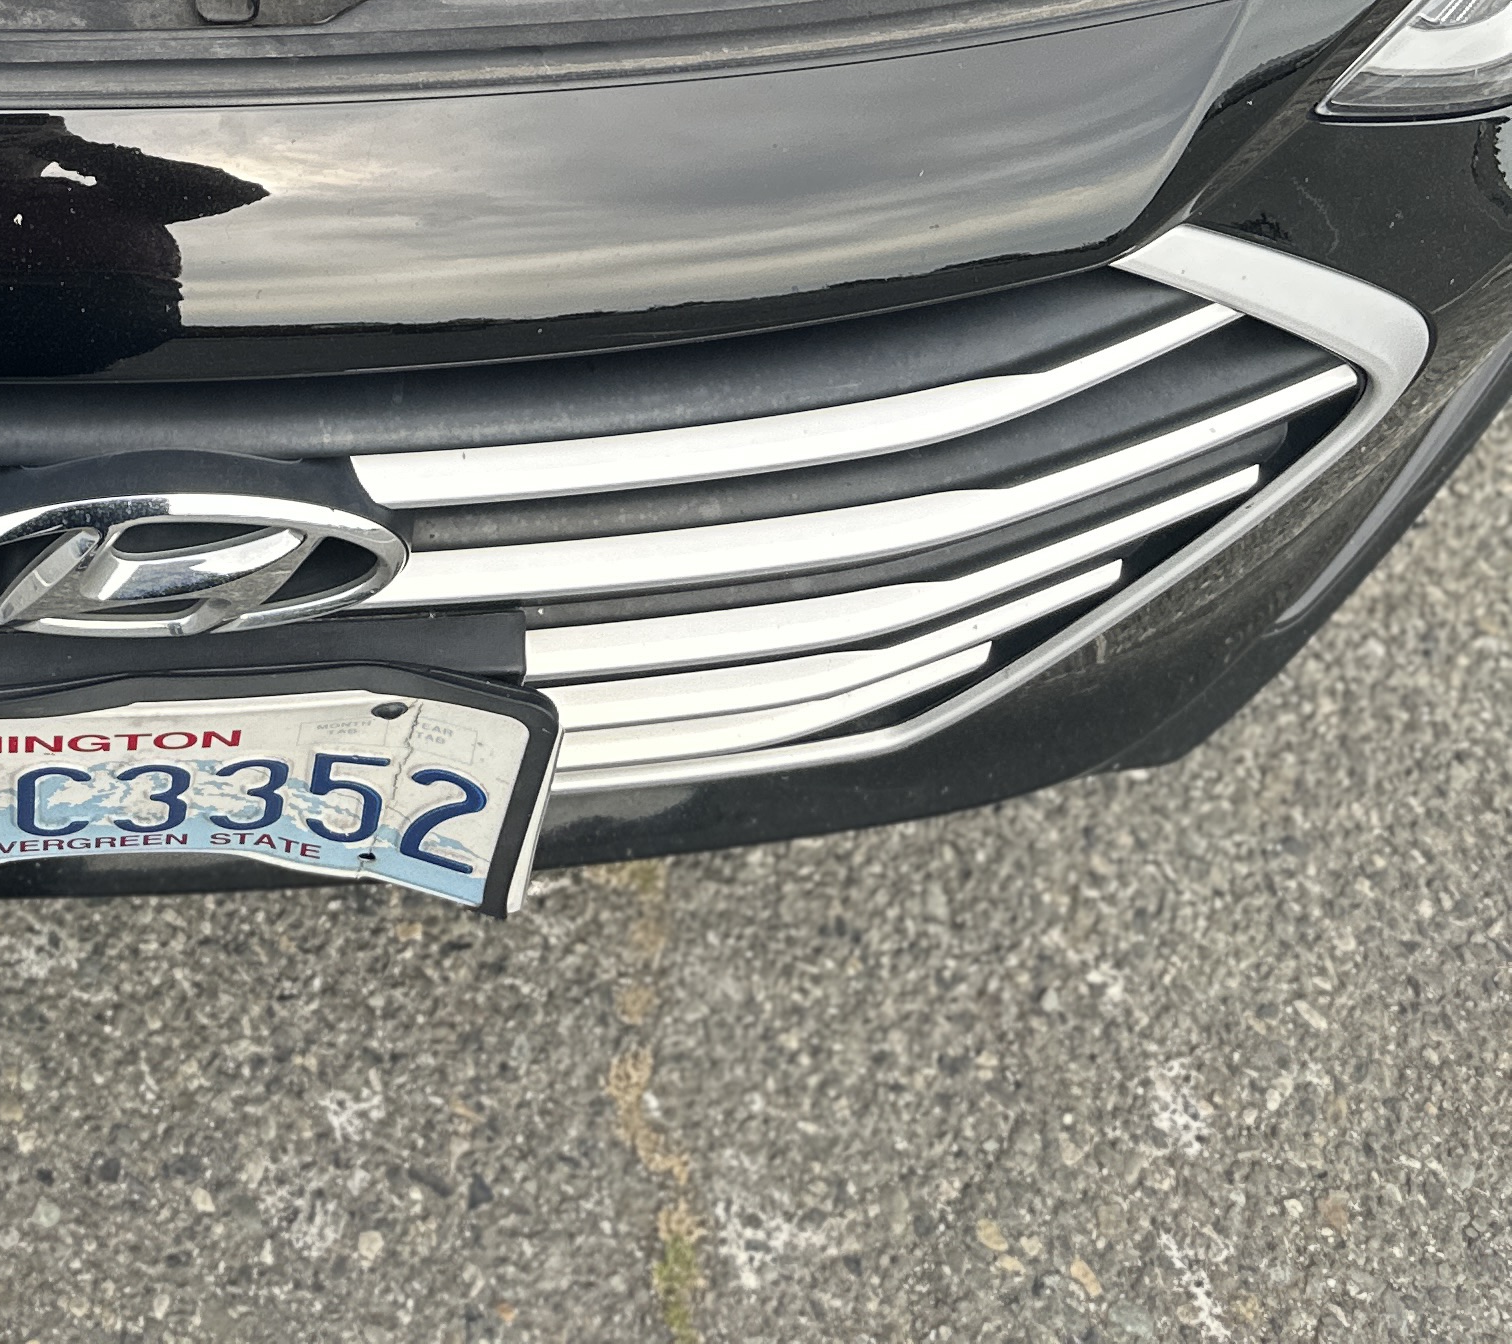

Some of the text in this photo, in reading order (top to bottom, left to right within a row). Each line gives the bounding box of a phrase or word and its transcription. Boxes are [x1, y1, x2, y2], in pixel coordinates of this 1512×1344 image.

[316, 720, 372, 731] MONTH
[327, 728, 358, 736] TAB
[414, 720, 454, 738] EAR
[416, 731, 446, 745] TAB
[210, 833, 321, 860] STATE
